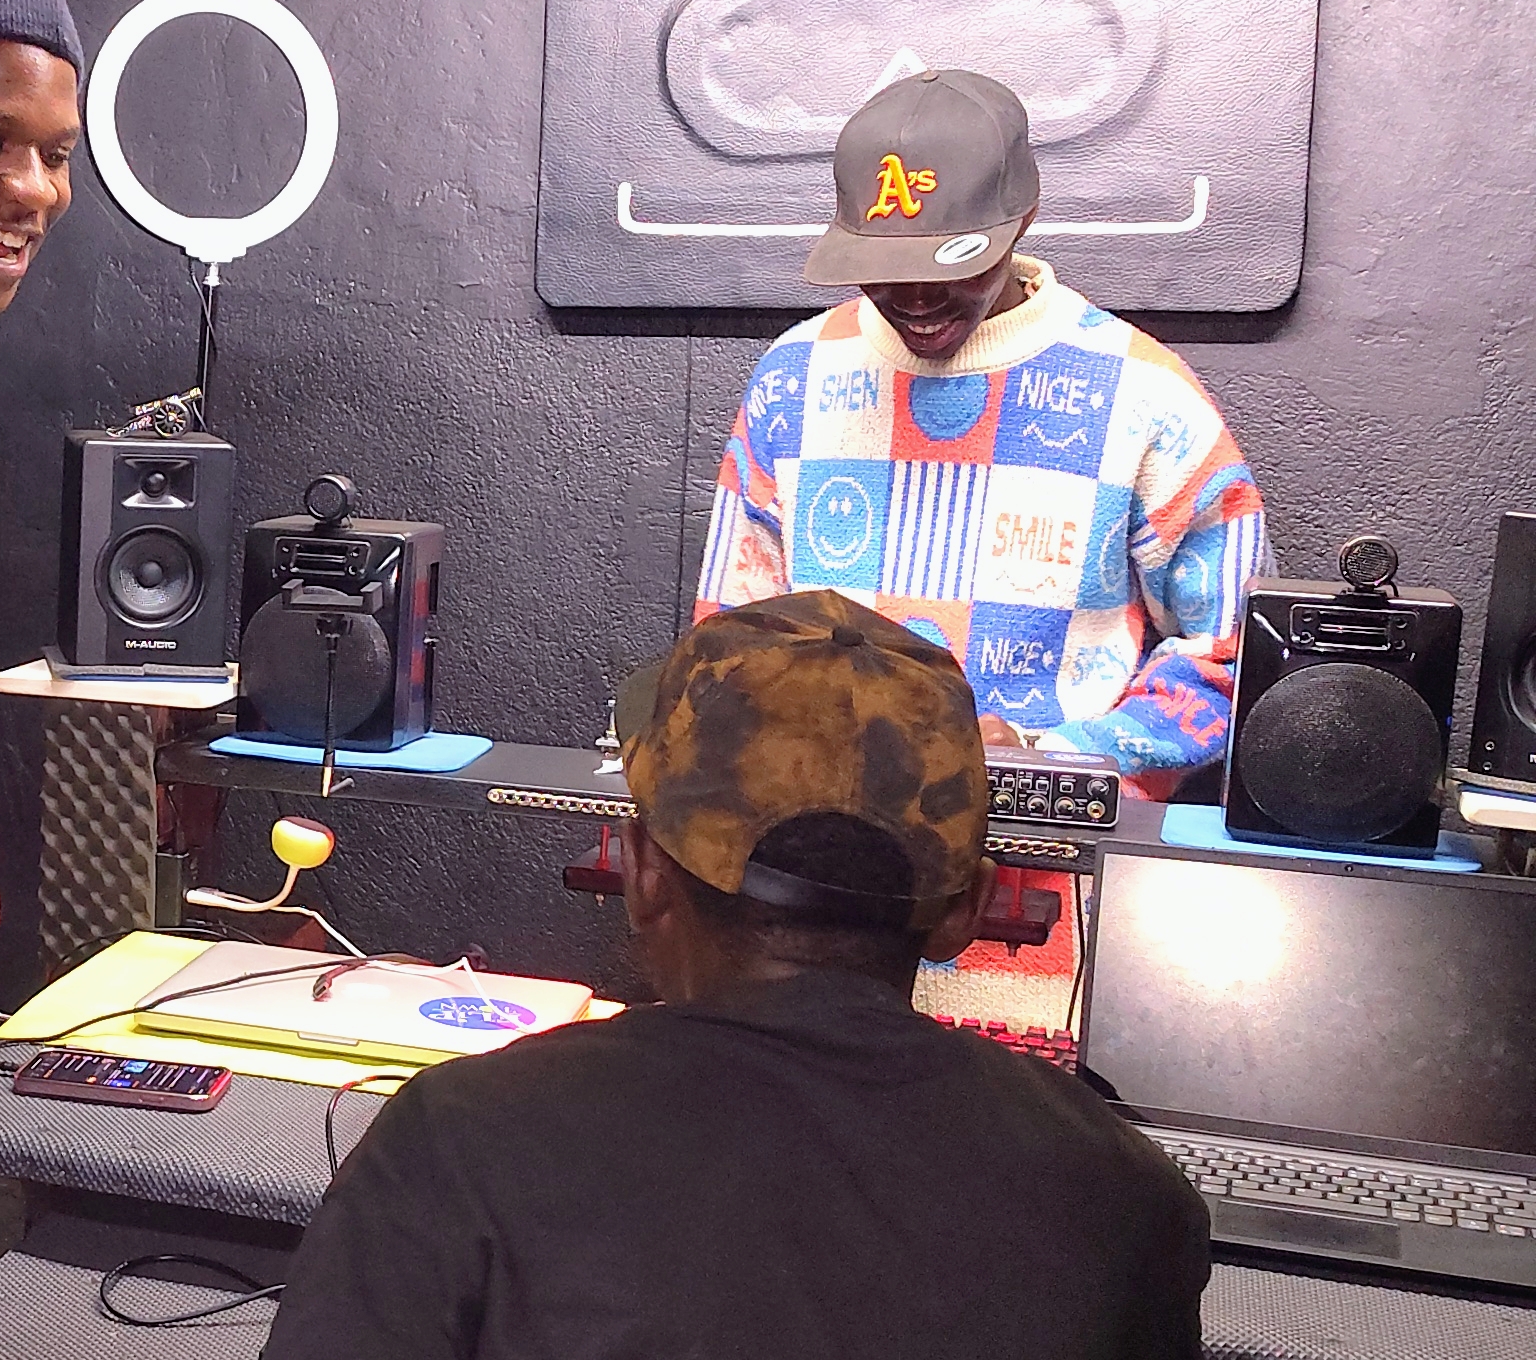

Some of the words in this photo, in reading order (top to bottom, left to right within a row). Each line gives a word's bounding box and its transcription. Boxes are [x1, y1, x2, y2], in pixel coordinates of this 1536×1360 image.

[866, 152, 939, 222] A's
[818, 367, 880, 413] SHEN
[1016, 367, 1090, 416] NICE
[991, 511, 1078, 566] SMILE
[125, 640, 177, 650] M-AUDIO
[979, 636, 1045, 676] NICE
